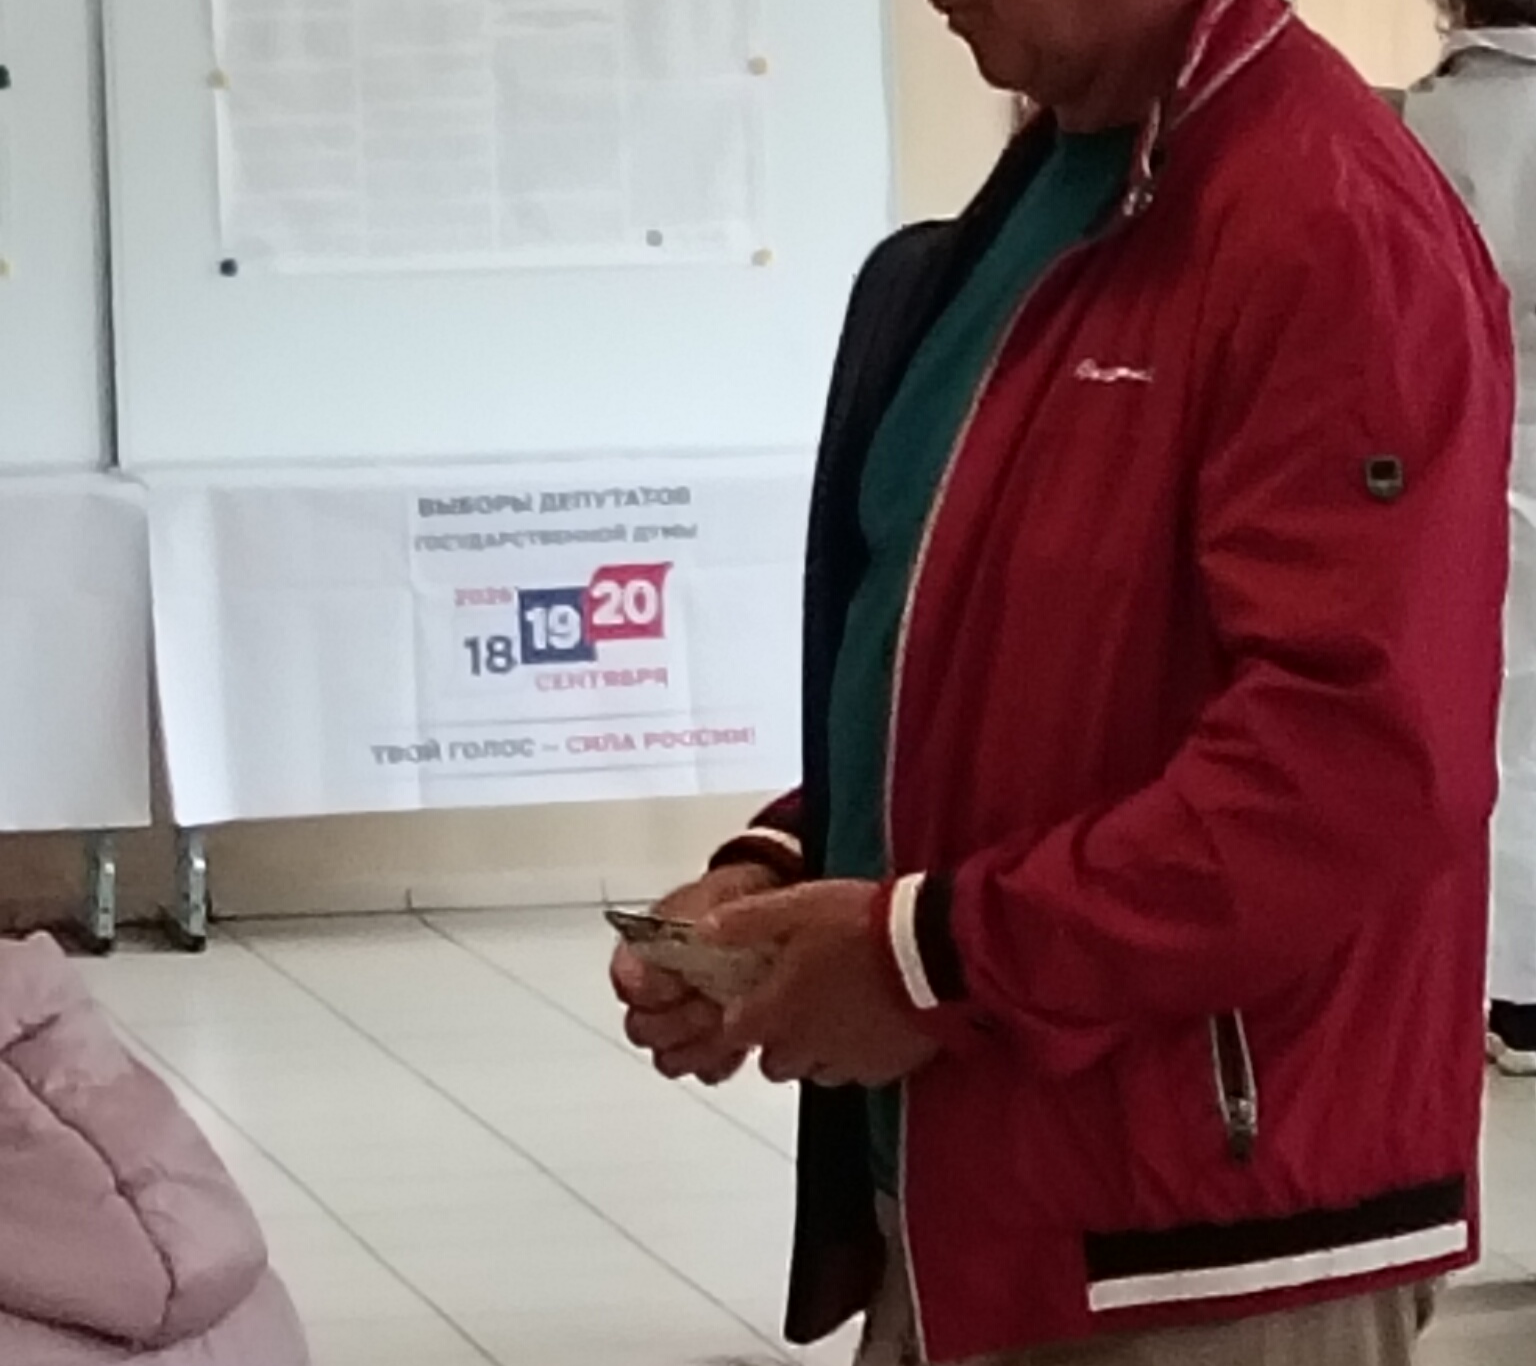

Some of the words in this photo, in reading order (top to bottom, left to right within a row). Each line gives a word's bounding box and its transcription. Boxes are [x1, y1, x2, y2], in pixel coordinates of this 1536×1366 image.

[417, 493, 533, 518] ВЫБОРЫ
[538, 486, 691, 514] ДЕПУТАТОВ
[463, 635, 517, 676] 18
[525, 604, 582, 651] 19
[590, 579, 658, 626] 20
[534, 668, 669, 691] СЕНТЯБРЯ
[371, 741, 442, 765] ТВОЙ
[448, 737, 535, 761] ГОЛОС
[565, 731, 637, 755] СИЛА
